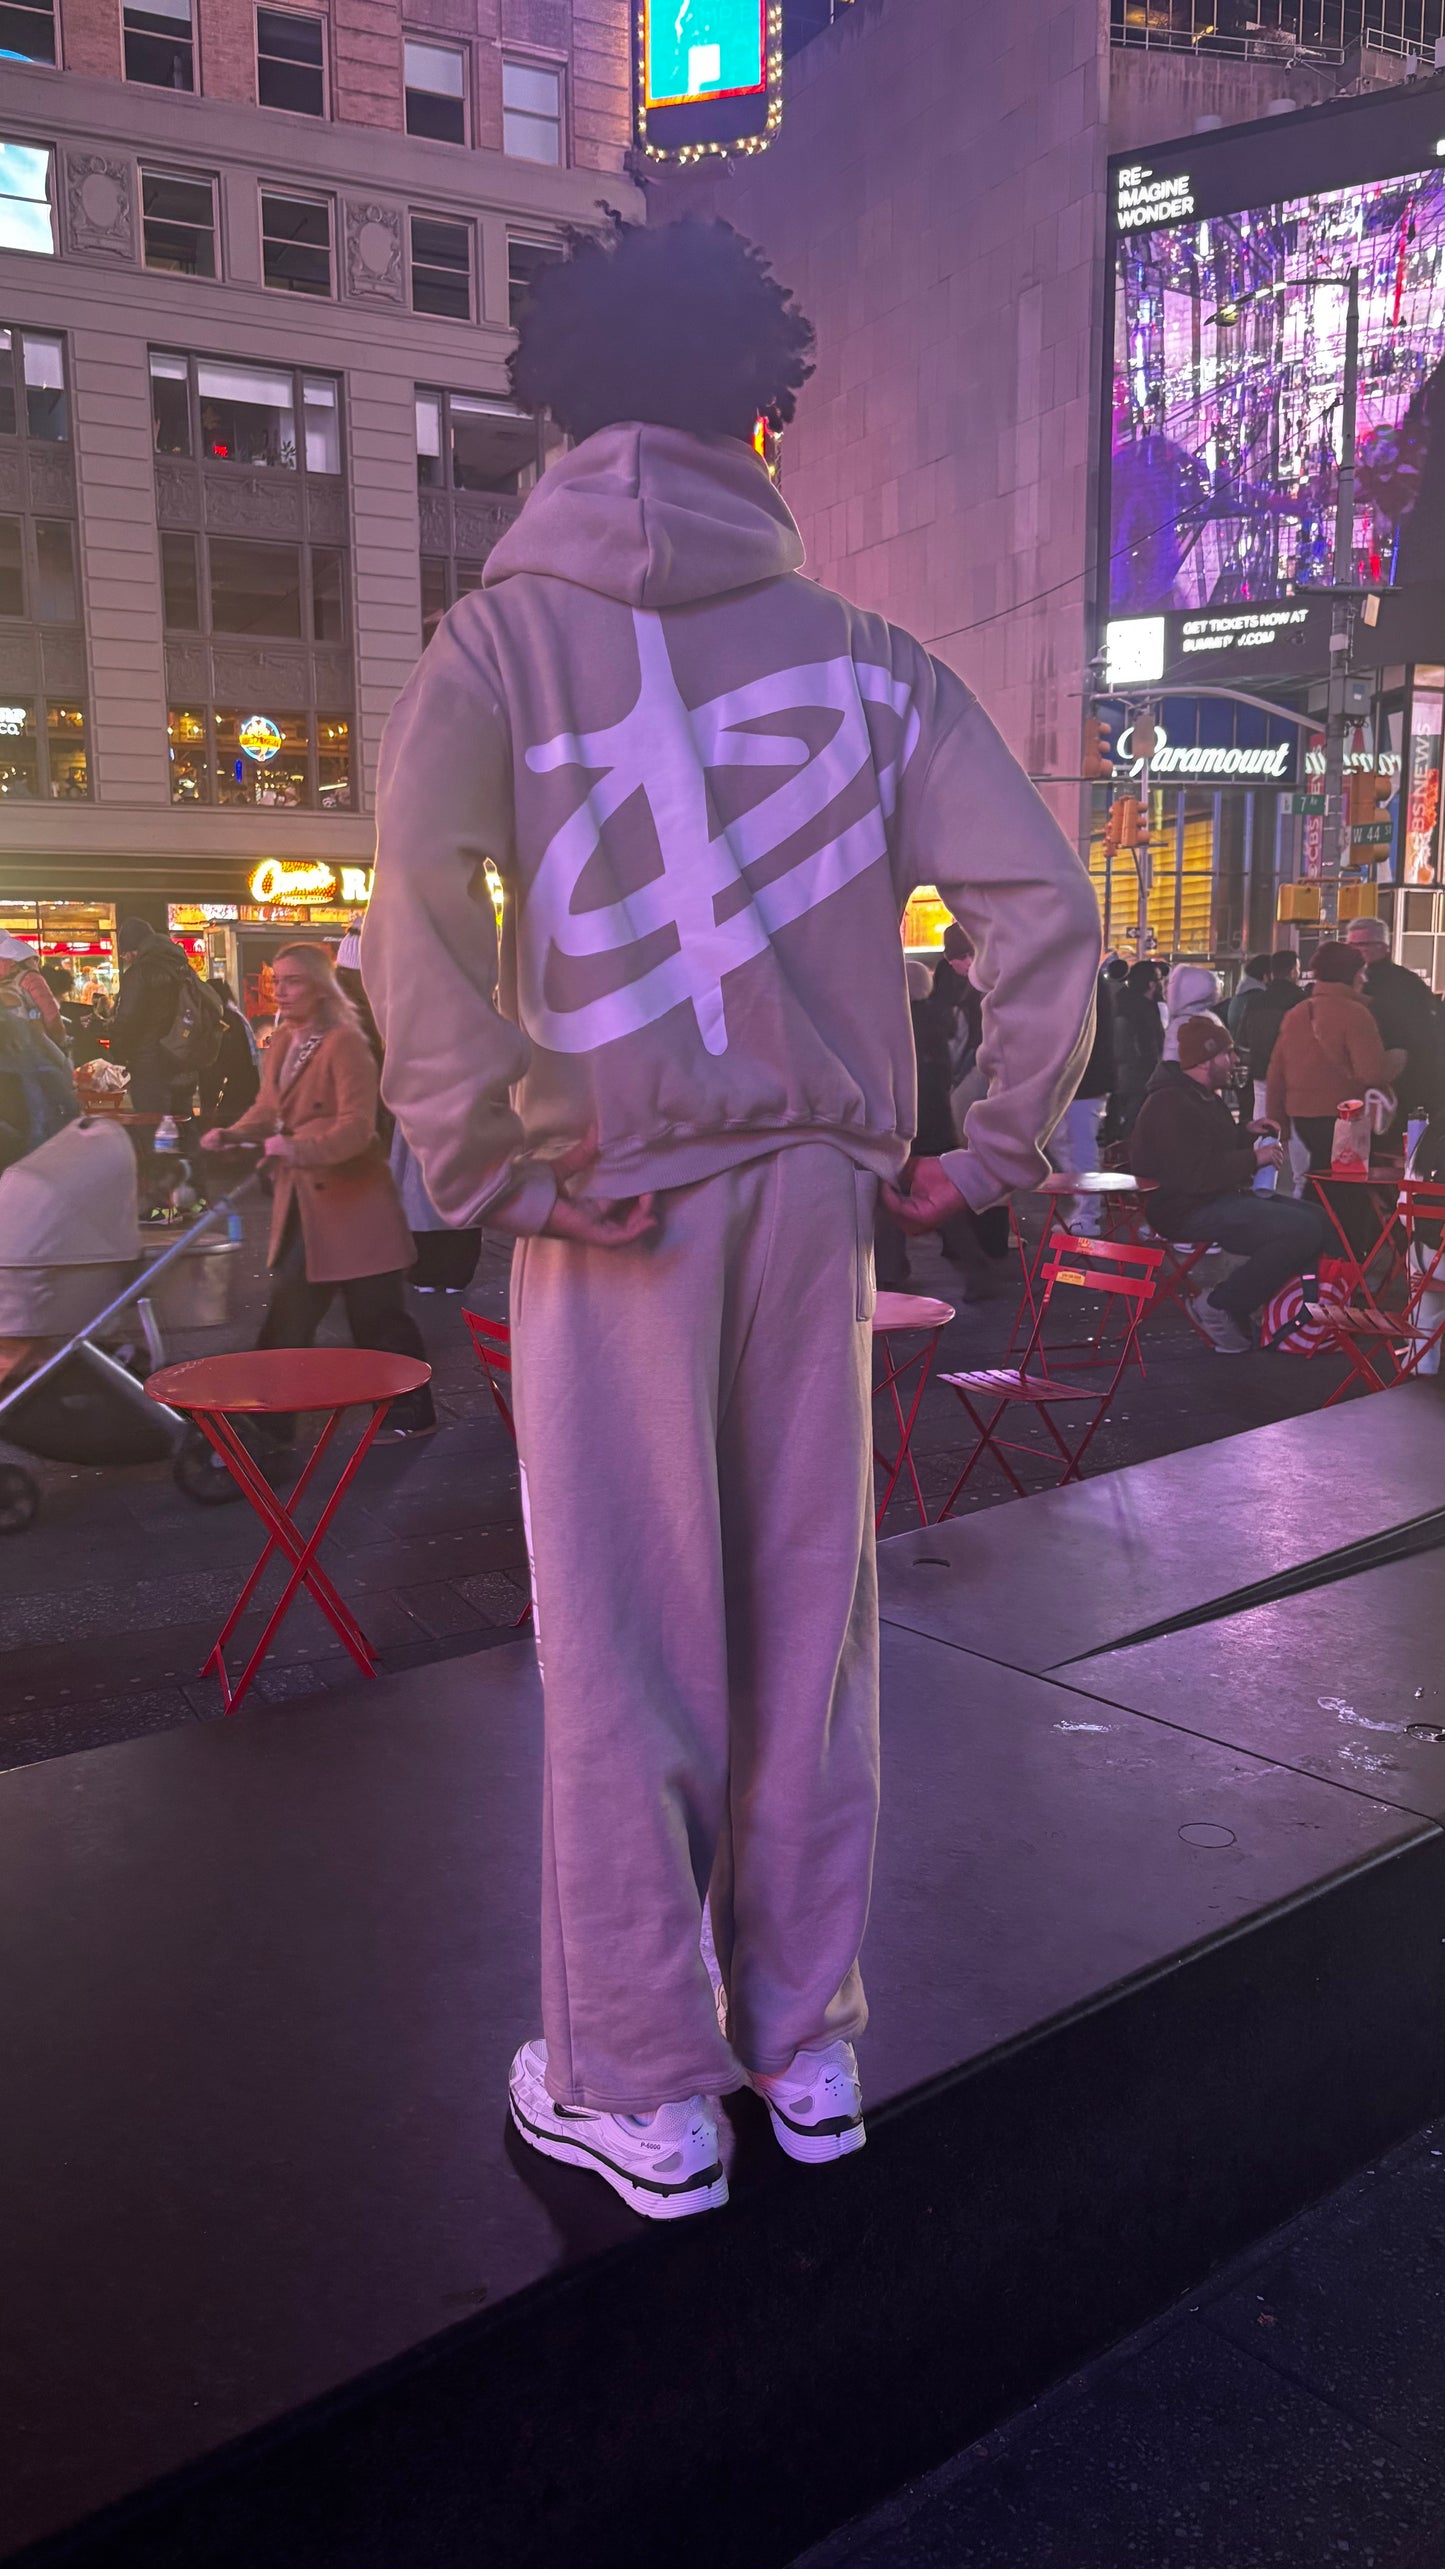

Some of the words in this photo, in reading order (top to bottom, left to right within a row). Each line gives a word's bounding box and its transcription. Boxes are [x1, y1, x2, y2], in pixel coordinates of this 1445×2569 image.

[1118, 166, 1153, 189] RE-
[1118, 175, 1190, 210] IMAGINE
[1117, 196, 1195, 230] WONDER
[1182, 619, 1208, 635] GET
[1209, 615, 1258, 632] TICKETS
[1260, 611, 1290, 627] NOW
[1290, 609, 1309, 624] AT
[1112, 725, 1290, 777] Paramount
[1300, 796, 1307, 813] 7
[1353, 827, 1363, 844] W
[1366, 826, 1381, 842] 44
[640, 2141, 661, 2150] P-6000
